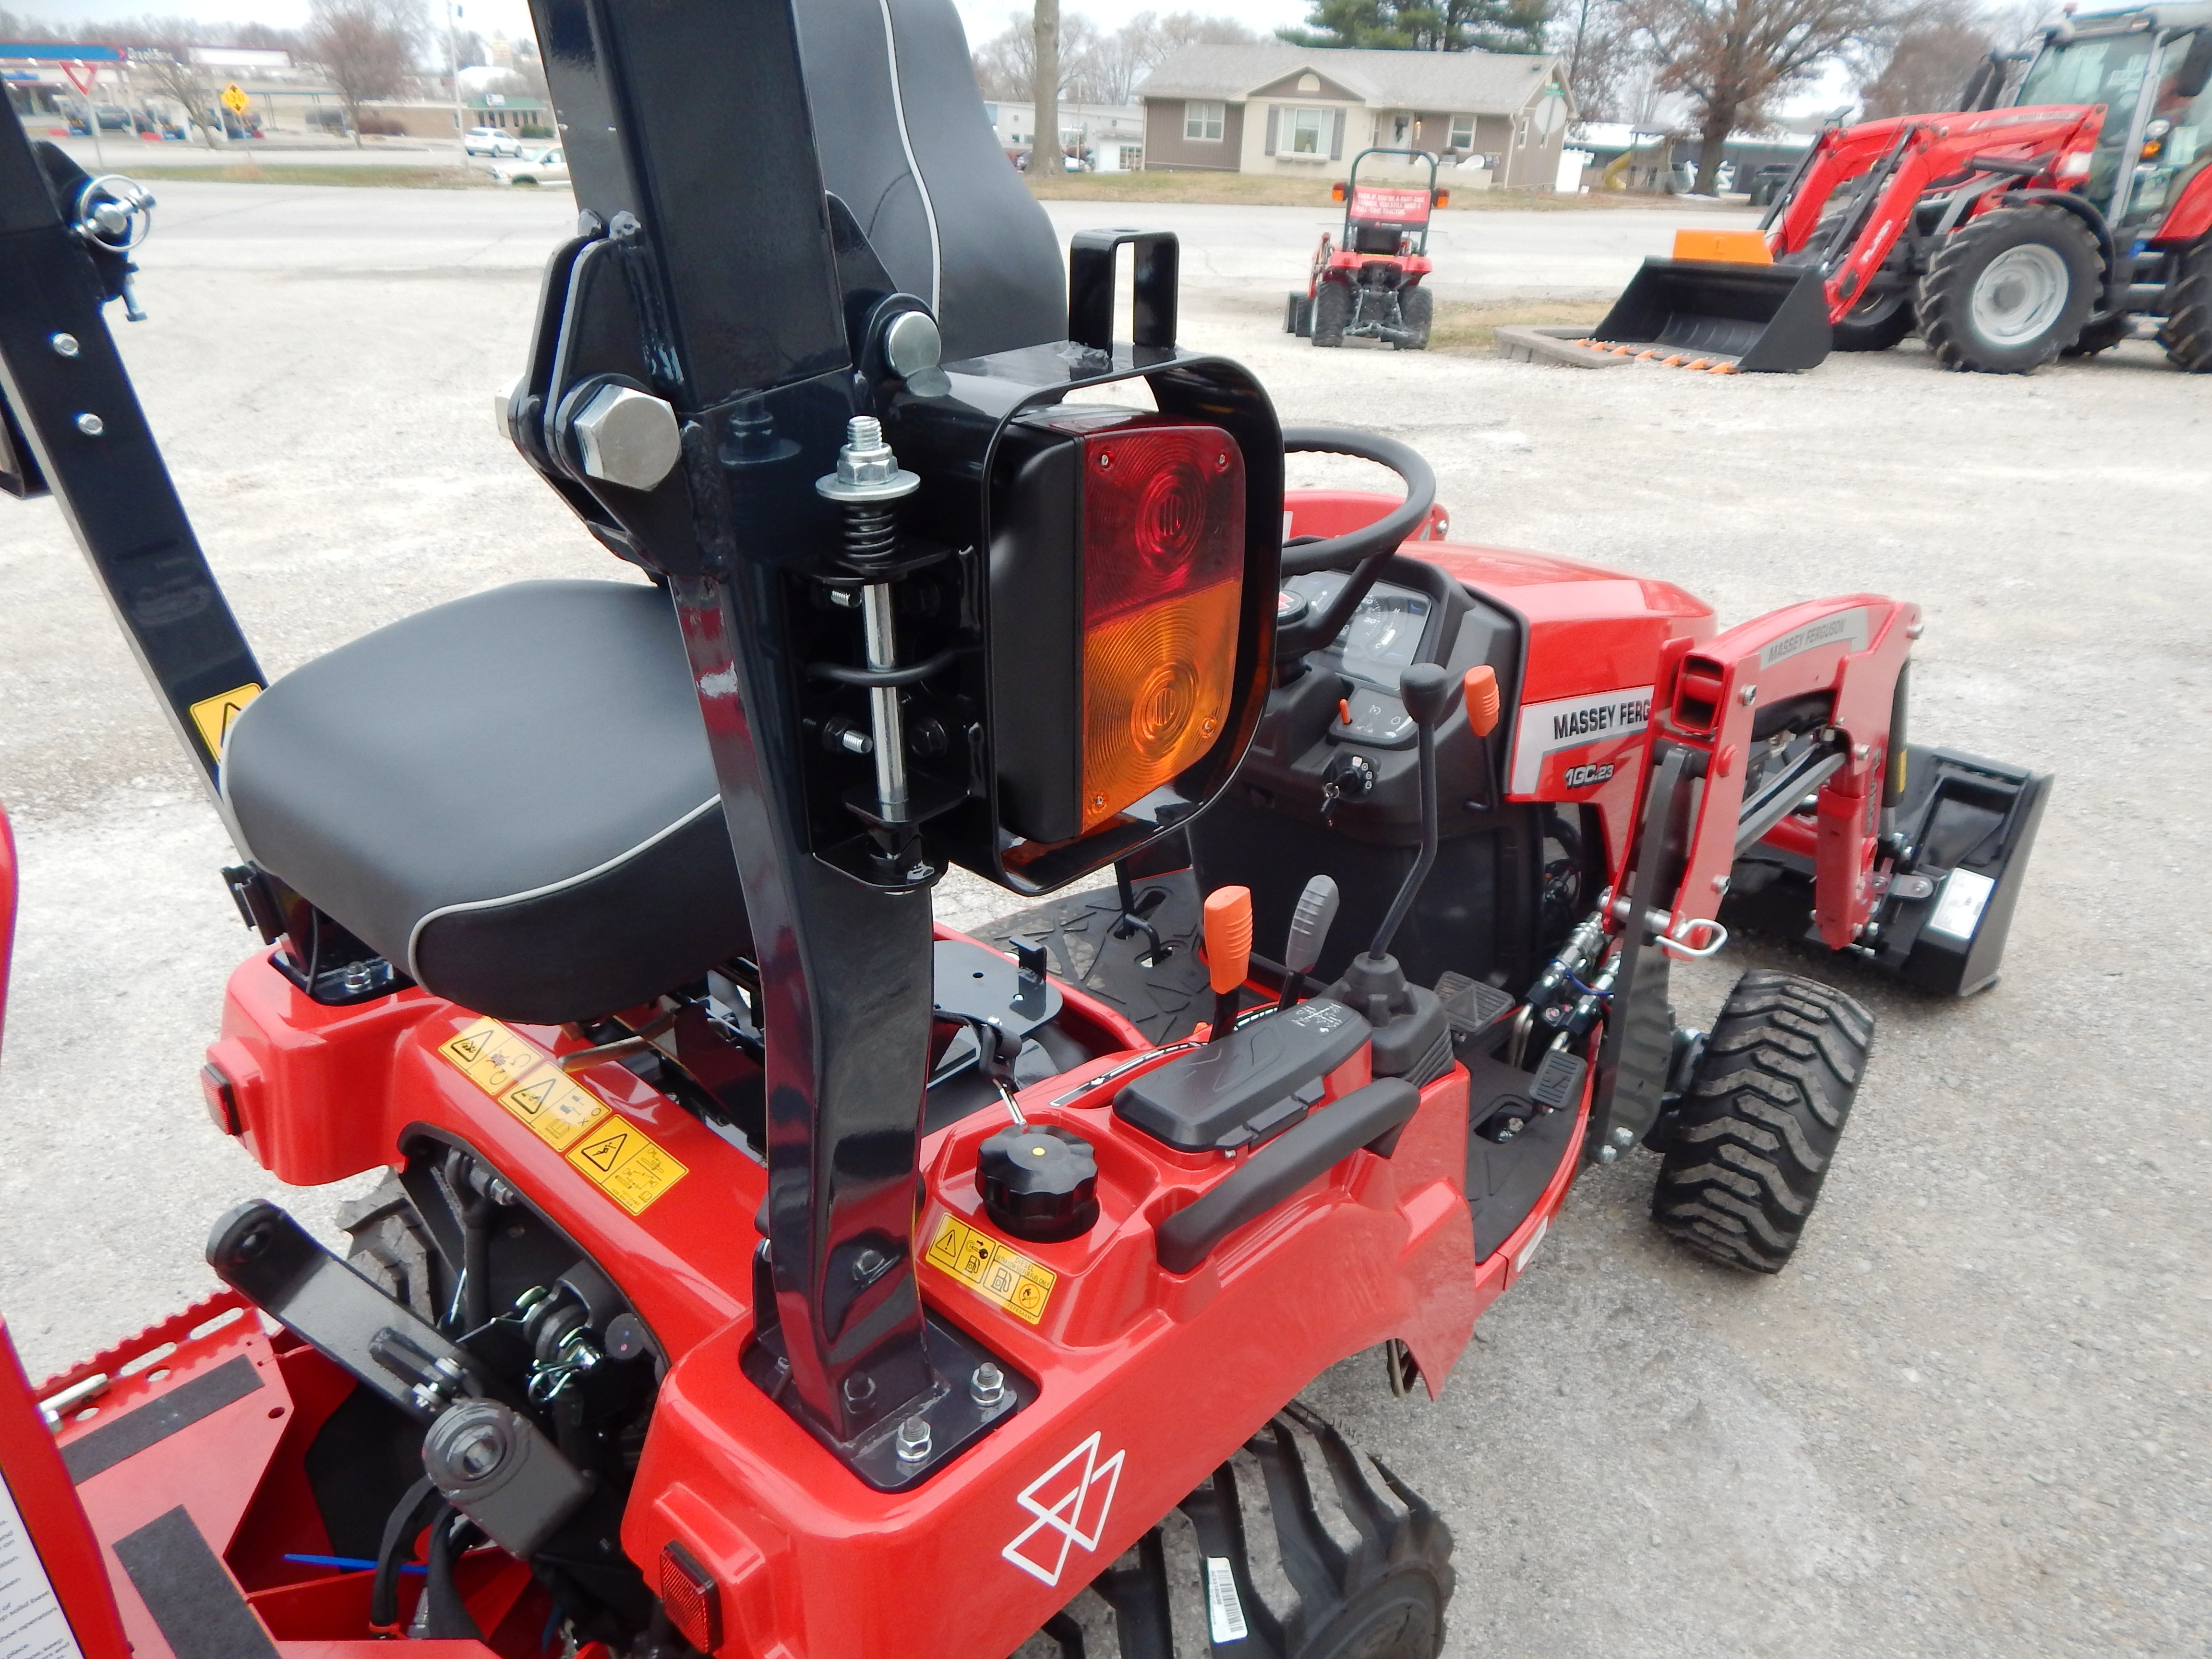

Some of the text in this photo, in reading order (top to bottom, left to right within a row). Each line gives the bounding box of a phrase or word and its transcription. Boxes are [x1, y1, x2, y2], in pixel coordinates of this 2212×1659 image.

[1768, 618, 1846, 662] MASSEY FERGUSON
[1554, 704, 1616, 740] MASSEY
[1565, 764, 1614, 787] 1GC.23
[996, 1254, 1007, 1264] ULTRA
[1008, 1260, 1016, 1269] LOW
[1030, 1273, 1039, 1282] FUEL
[1039, 1277, 1050, 1287] ONLY
[1015, 1257, 1034, 1272] DIESEL
